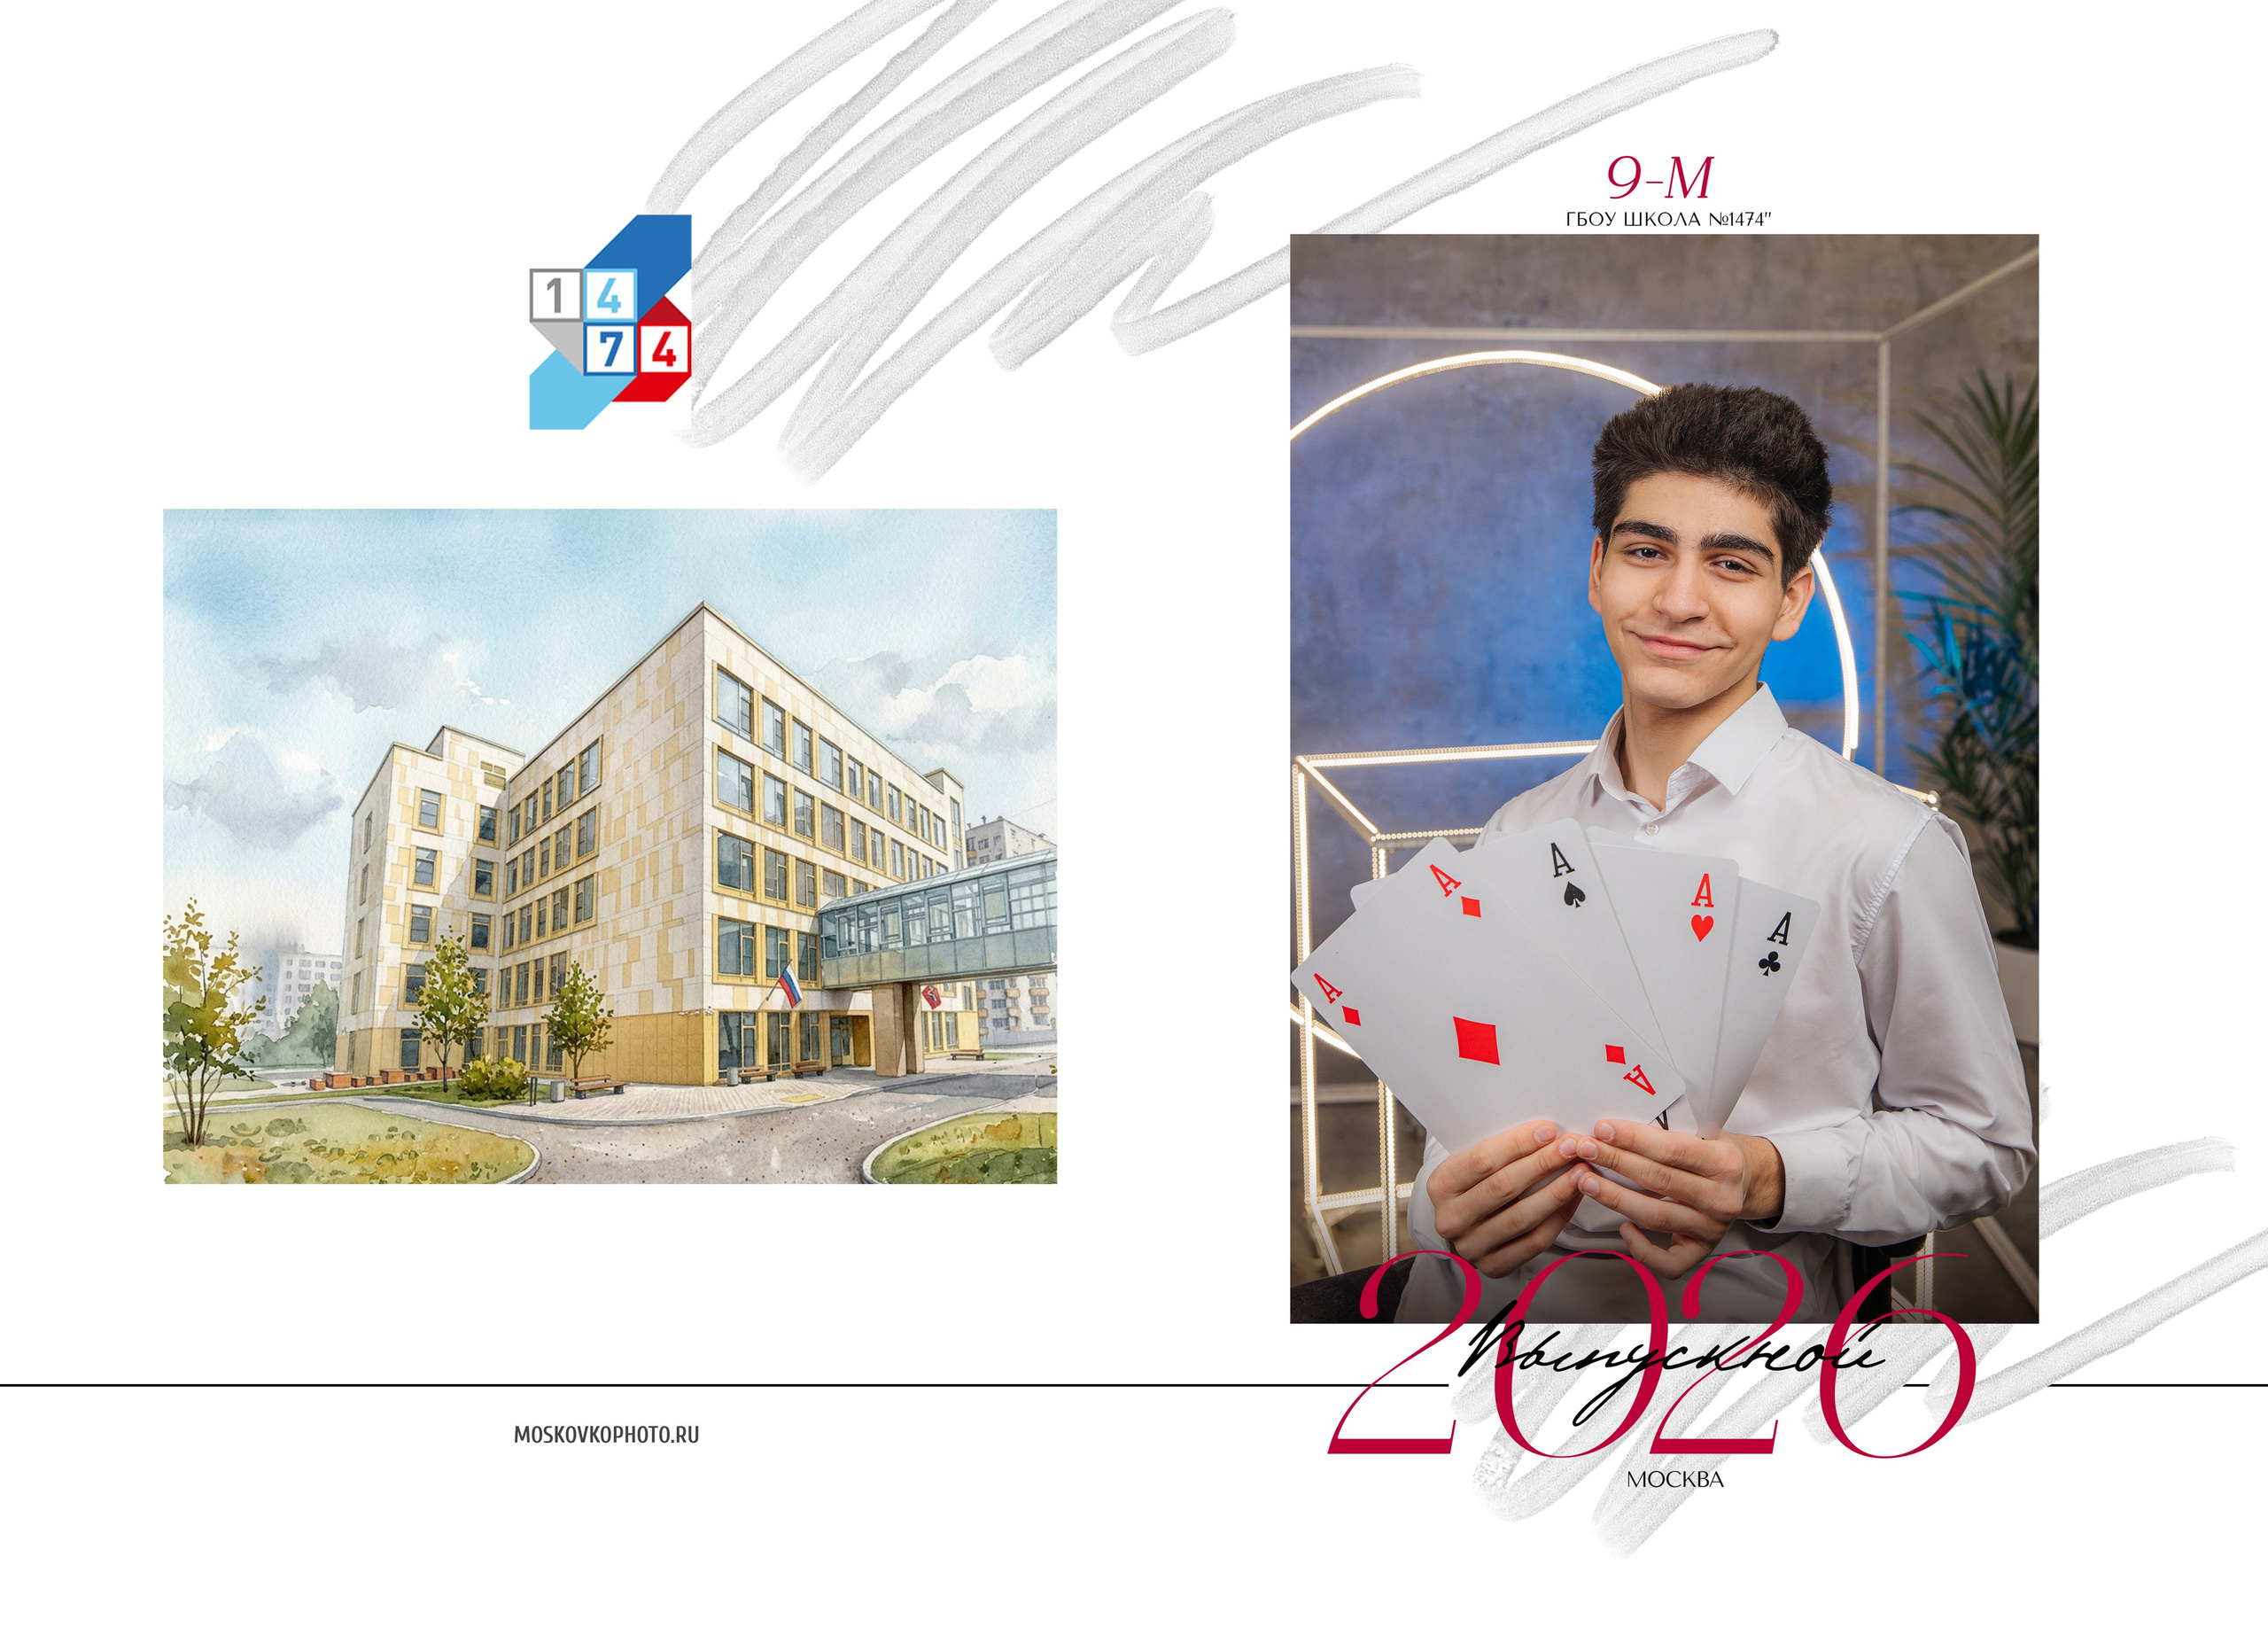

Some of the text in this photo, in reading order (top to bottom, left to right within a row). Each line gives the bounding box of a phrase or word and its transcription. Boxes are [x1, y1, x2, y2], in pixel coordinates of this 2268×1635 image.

[1551, 842, 1575, 878] A
[1429, 864, 1462, 897] A
[1690, 873, 1715, 908] A
[1767, 911, 1792, 946] A
[1313, 973, 1344, 1005] A
[1622, 1063, 1657, 1096] A
